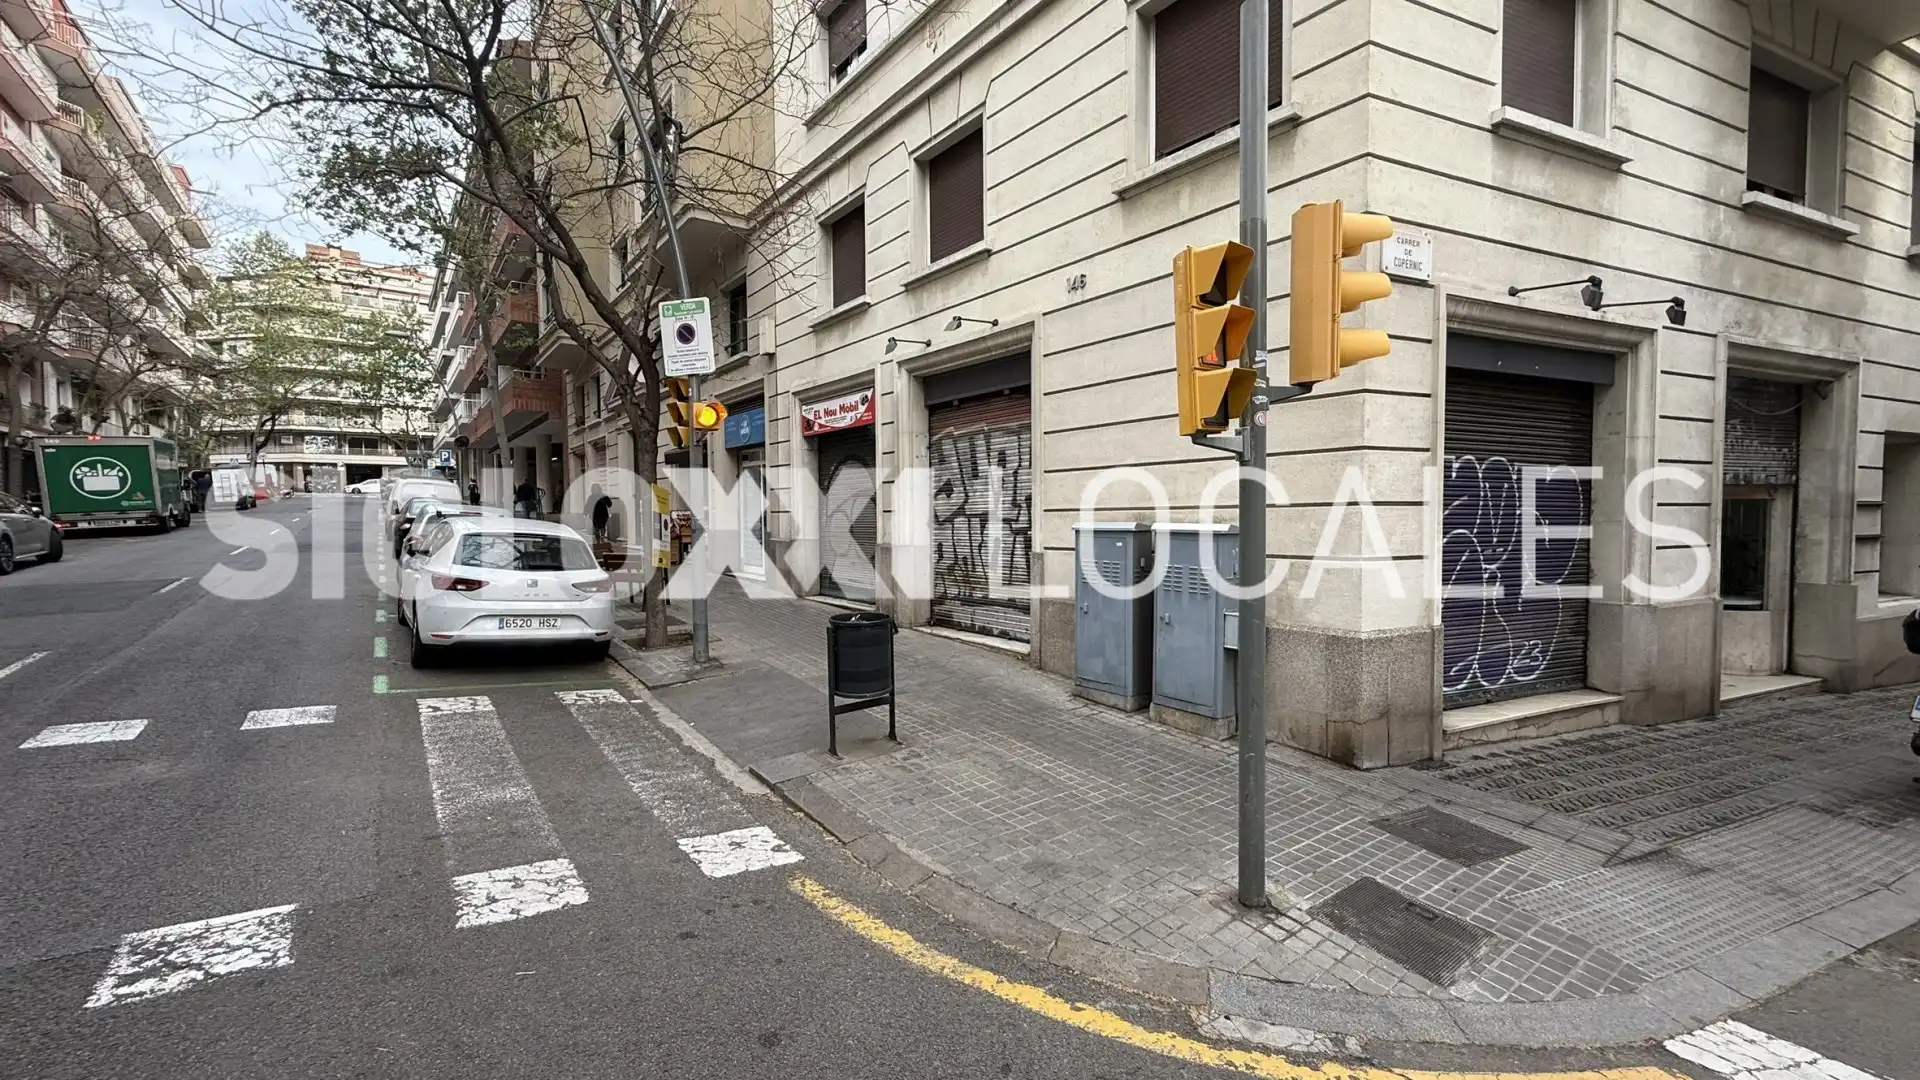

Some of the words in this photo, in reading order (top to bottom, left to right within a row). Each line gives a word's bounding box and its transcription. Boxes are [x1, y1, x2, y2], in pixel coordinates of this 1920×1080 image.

[1396, 237, 1420, 247] CARRER
[1404, 248, 1413, 256] DE
[813, 409, 822, 420] EL
[824, 407, 837, 419] Nou
[441, 451, 449, 462] P
[504, 618, 533, 628] 6520
[538, 618, 559, 628] HSZ
